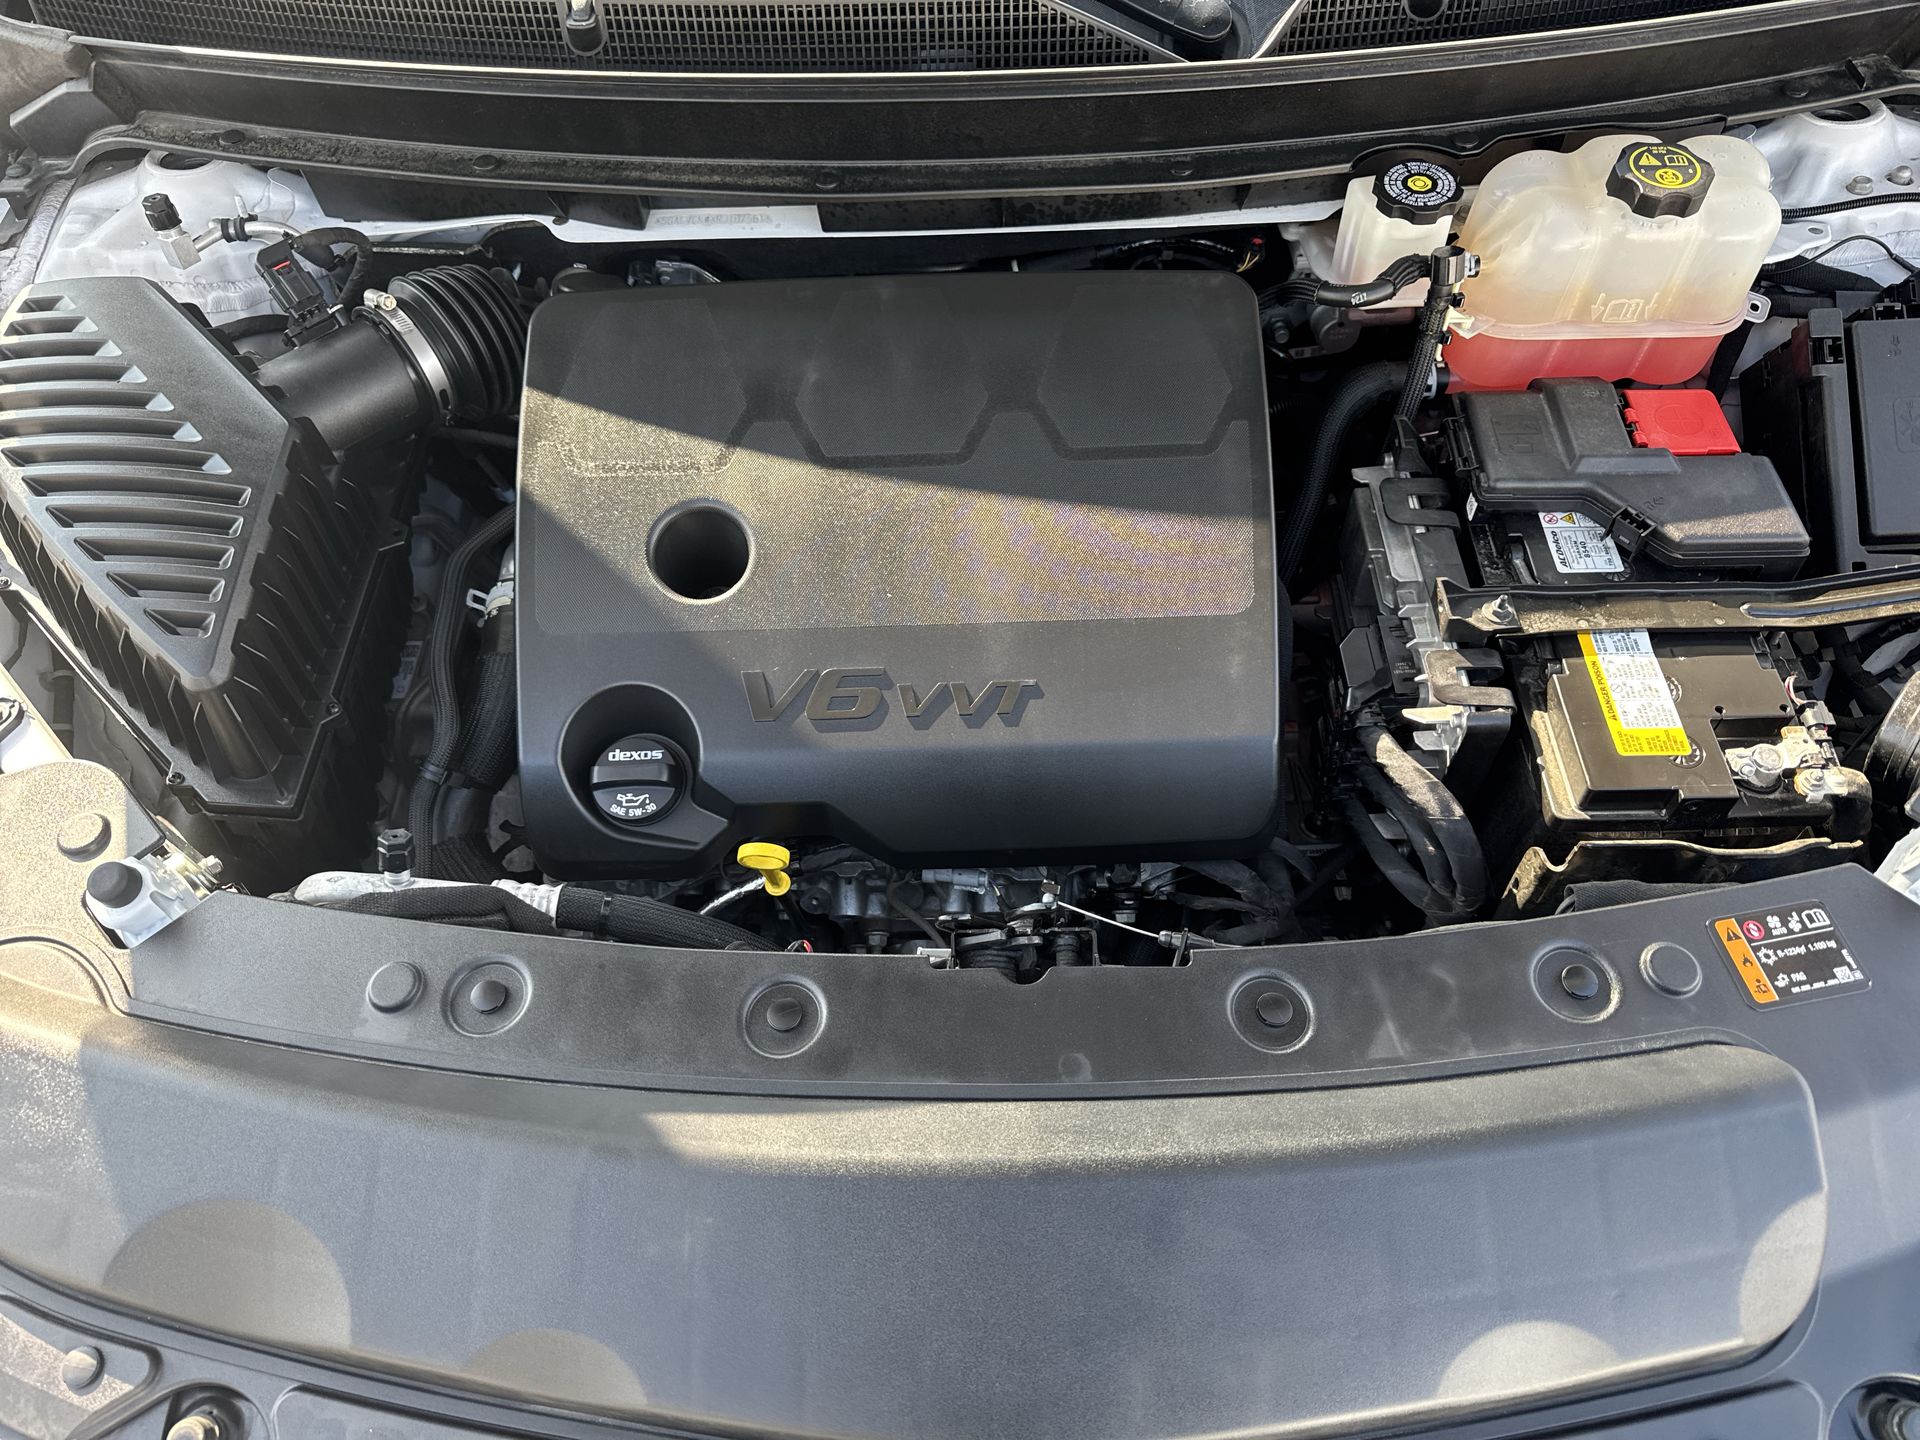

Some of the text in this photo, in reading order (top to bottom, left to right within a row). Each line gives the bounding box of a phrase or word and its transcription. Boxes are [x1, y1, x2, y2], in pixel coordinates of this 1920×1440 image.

[1551, 530, 1569, 568] ACDelco
[1580, 541, 1591, 558] 8540
[741, 667, 1037, 722] V6 VVT
[1590, 660, 1615, 715] DANGER POISON
[608, 749, 665, 761] dexos
[610, 803, 657, 816] SAE 5W-30
[1771, 926, 1788, 936] AUTO
[1790, 971, 1807, 982] PAG
